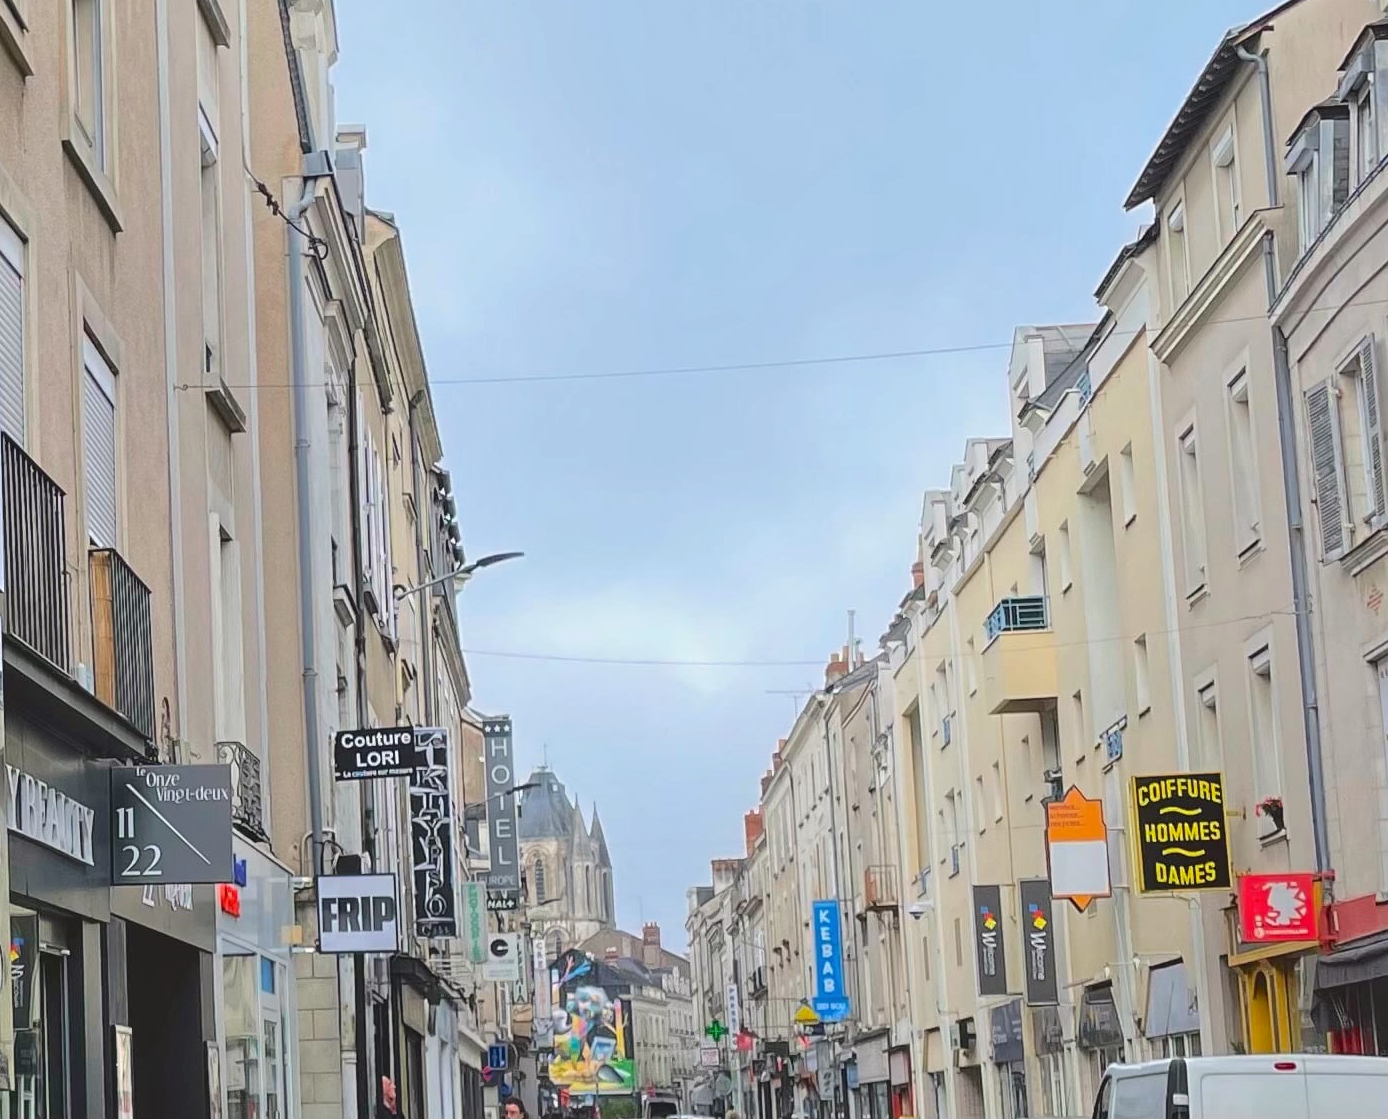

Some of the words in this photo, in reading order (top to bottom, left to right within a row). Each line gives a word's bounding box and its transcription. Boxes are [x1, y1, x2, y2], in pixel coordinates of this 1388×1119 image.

[341, 732, 411, 749] Couture
[135, 766, 147, 777] Le
[356, 750, 400, 768] LORI
[146, 771, 180, 788] Onze
[155, 785, 229, 804] Vingt-deux
[490, 737, 513, 866] HOTEL
[1137, 778, 1222, 807] COIFFURE
[115, 806, 135, 839] 11
[1144, 820, 1221, 843] HOMMES
[121, 844, 163, 877] 22
[1155, 861, 1217, 886] DAMES
[322, 895, 396, 932] FRIP
[818, 909, 835, 993] KEBAB
